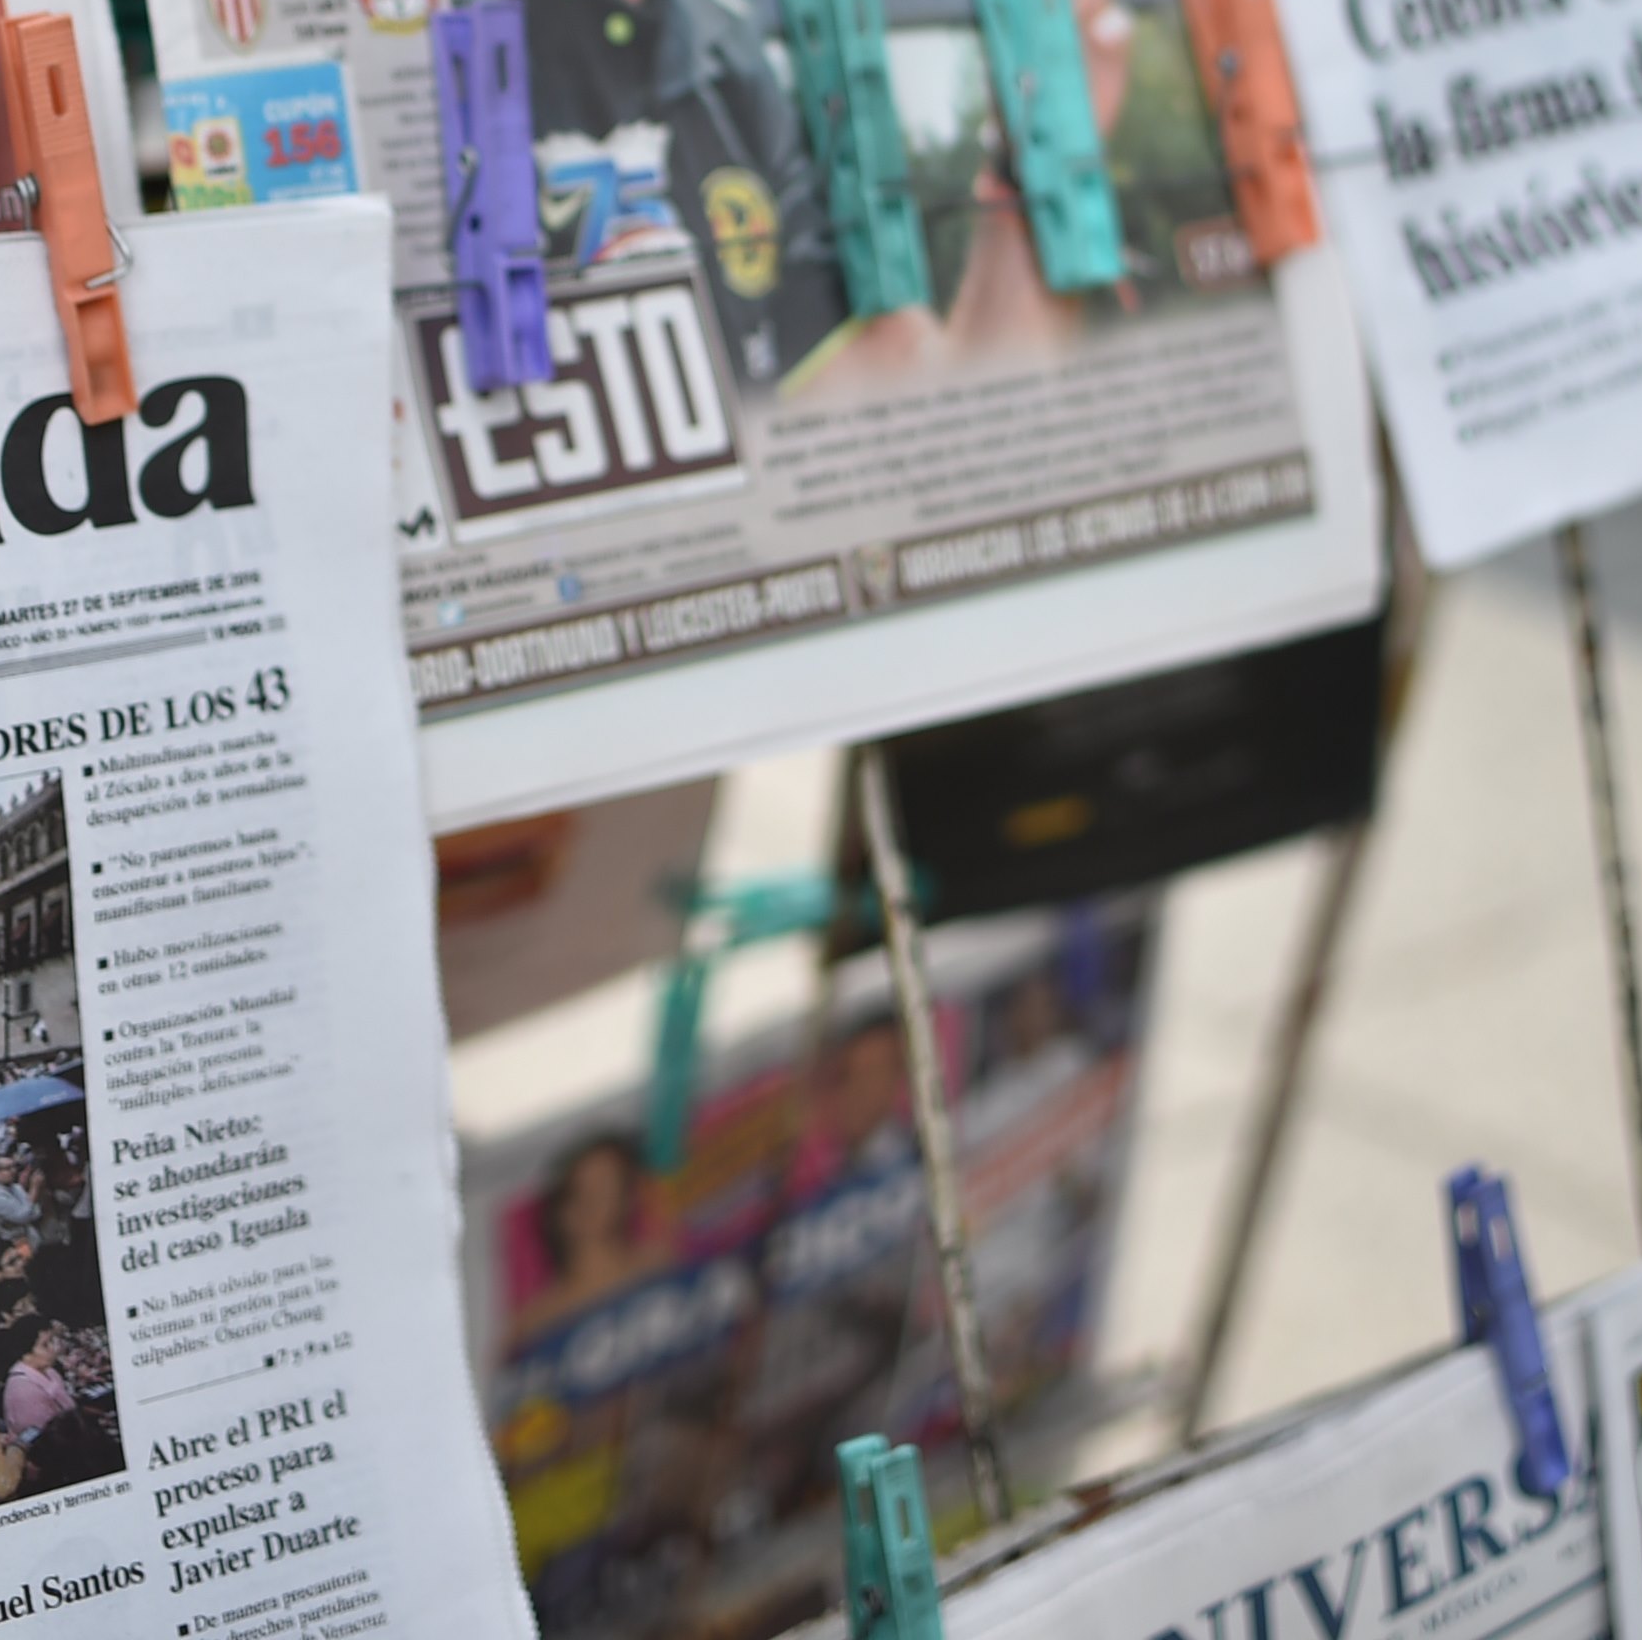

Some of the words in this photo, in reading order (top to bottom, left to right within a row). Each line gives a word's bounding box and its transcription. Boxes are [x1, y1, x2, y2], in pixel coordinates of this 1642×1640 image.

[1445, 53, 1611, 160] firma
[262, 120, 342, 168] 156
[83, 595, 104, 612] DE
[109, 577, 201, 608] SEPTIEMBRE
[99, 698, 152, 742] DE
[164, 683, 236, 731] LOS
[245, 666, 290, 715] 43
[111, 1132, 175, 1166] Peña
[183, 1115, 263, 1149] Nieto:
[113, 1180, 140, 1202] se
[147, 1139, 289, 1193] ahondarán
[115, 1173, 307, 1238] investigaciones
[121, 1240, 160, 1273] del
[166, 1229, 222, 1261] caso
[229, 1206, 309, 1248] Iguala
[148, 1429, 217, 1471] Abre
[225, 1416, 251, 1448] el
[258, 1398, 315, 1440] PRI
[322, 1389, 349, 1419] el
[153, 1461, 261, 1517] proceso
[268, 1441, 335, 1485] para
[161, 1496, 280, 1550] expulsar
[288, 1490, 307, 1514] a
[41, 1560, 146, 1612] Santos
[169, 1545, 256, 1595] Javier
[261, 1512, 362, 1563] Duarte
